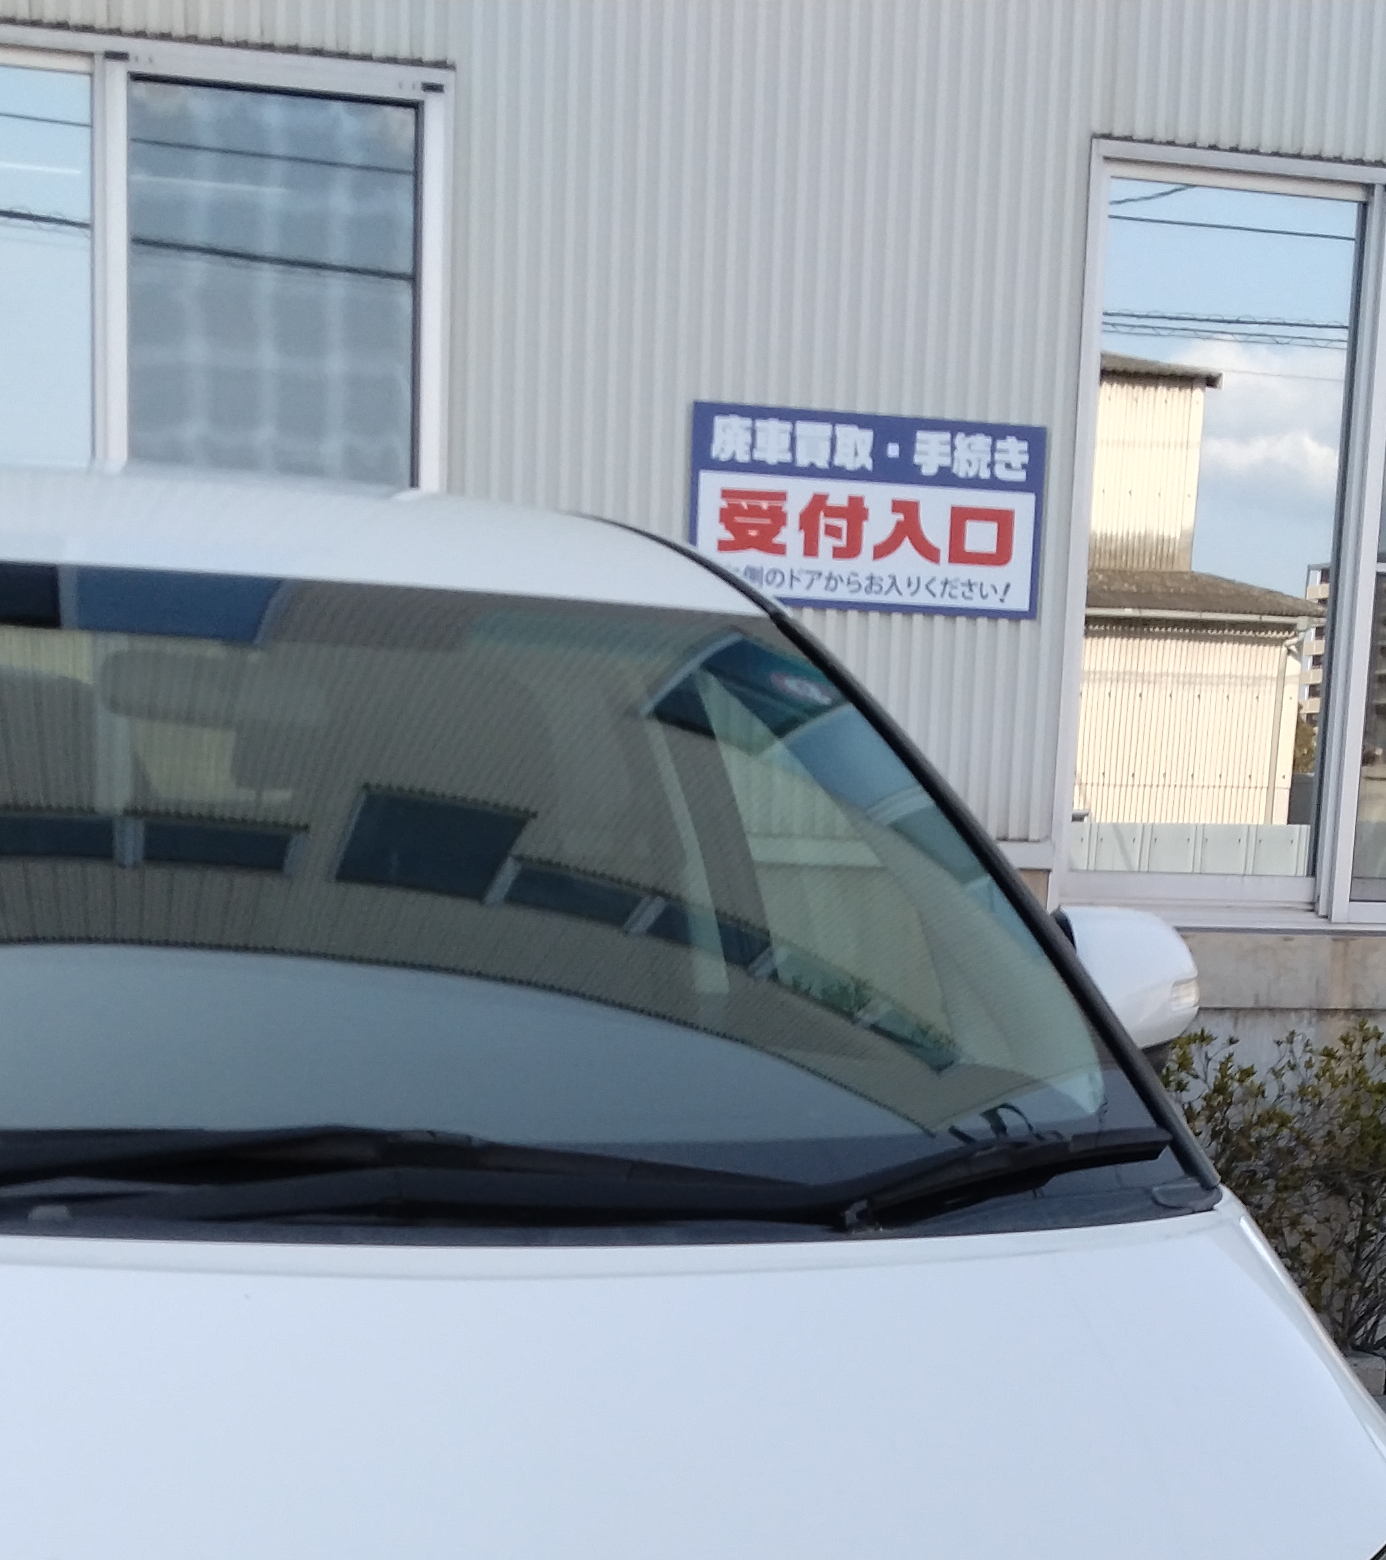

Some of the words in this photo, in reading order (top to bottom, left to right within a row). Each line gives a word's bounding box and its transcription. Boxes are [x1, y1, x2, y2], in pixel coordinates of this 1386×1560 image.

[711, 414, 1029, 482] 廃車買取・手続き
[717, 487, 1015, 567] 受付入口
[725, 562, 1012, 603] 側のドアからお入りください!
